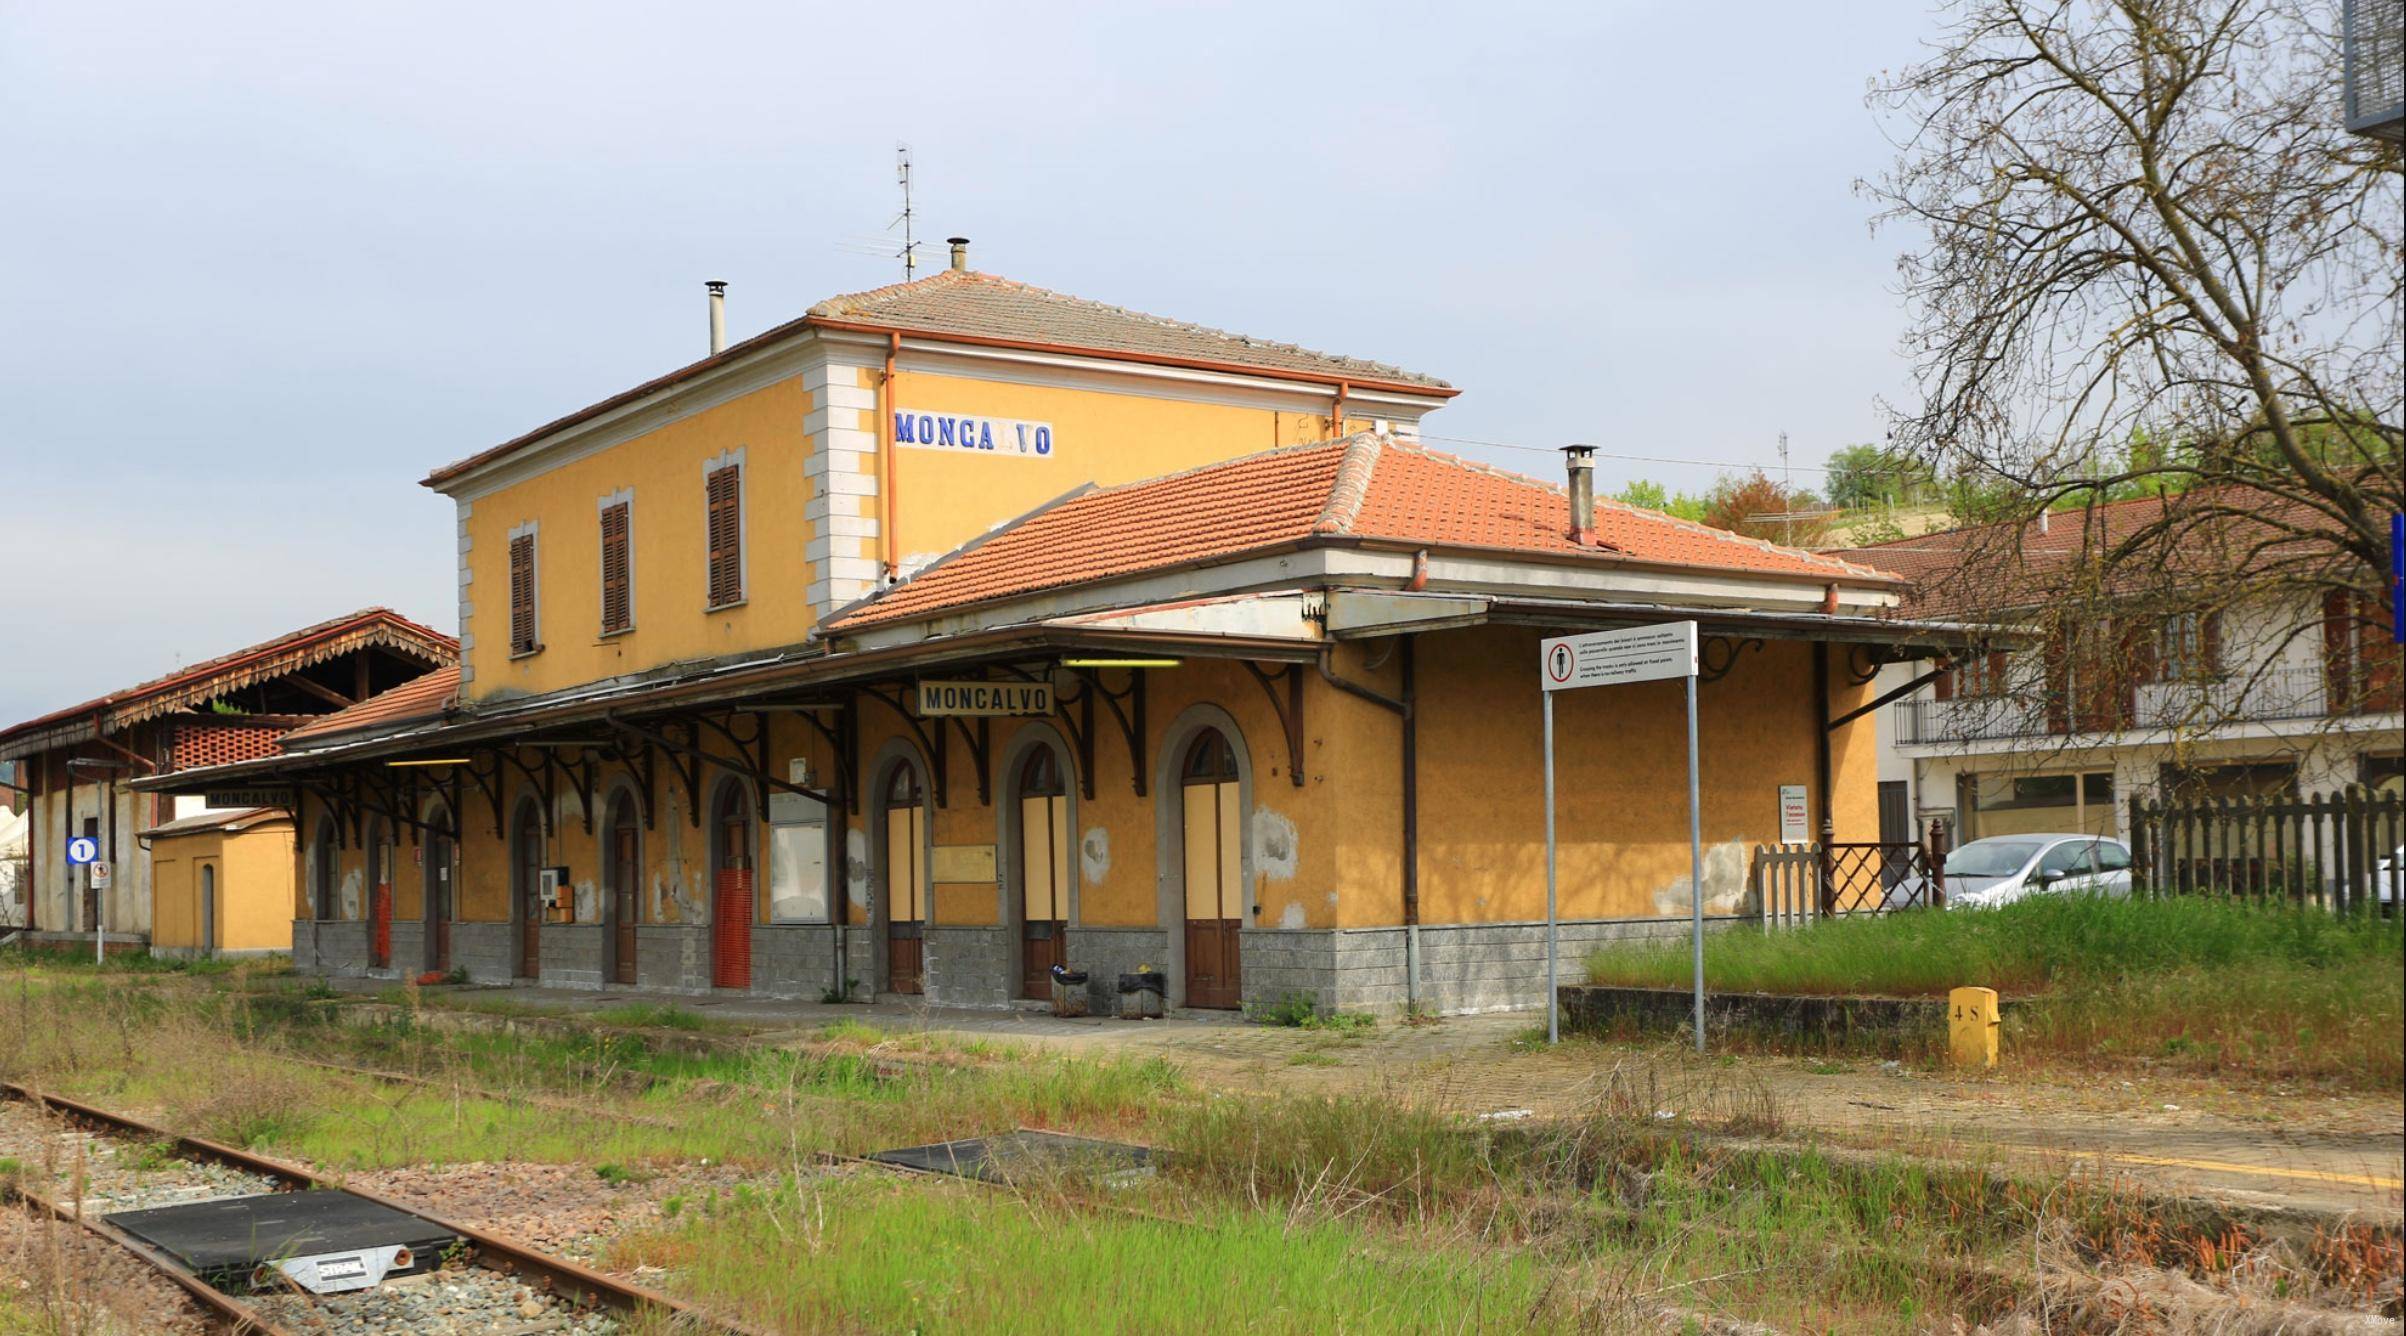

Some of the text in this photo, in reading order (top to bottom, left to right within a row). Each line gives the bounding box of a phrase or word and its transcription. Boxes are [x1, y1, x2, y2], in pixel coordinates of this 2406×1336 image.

[926, 686, 1047, 710] MONCALVO
[210, 791, 289, 804] MONCALVO
[78, 843, 85, 858] 1
